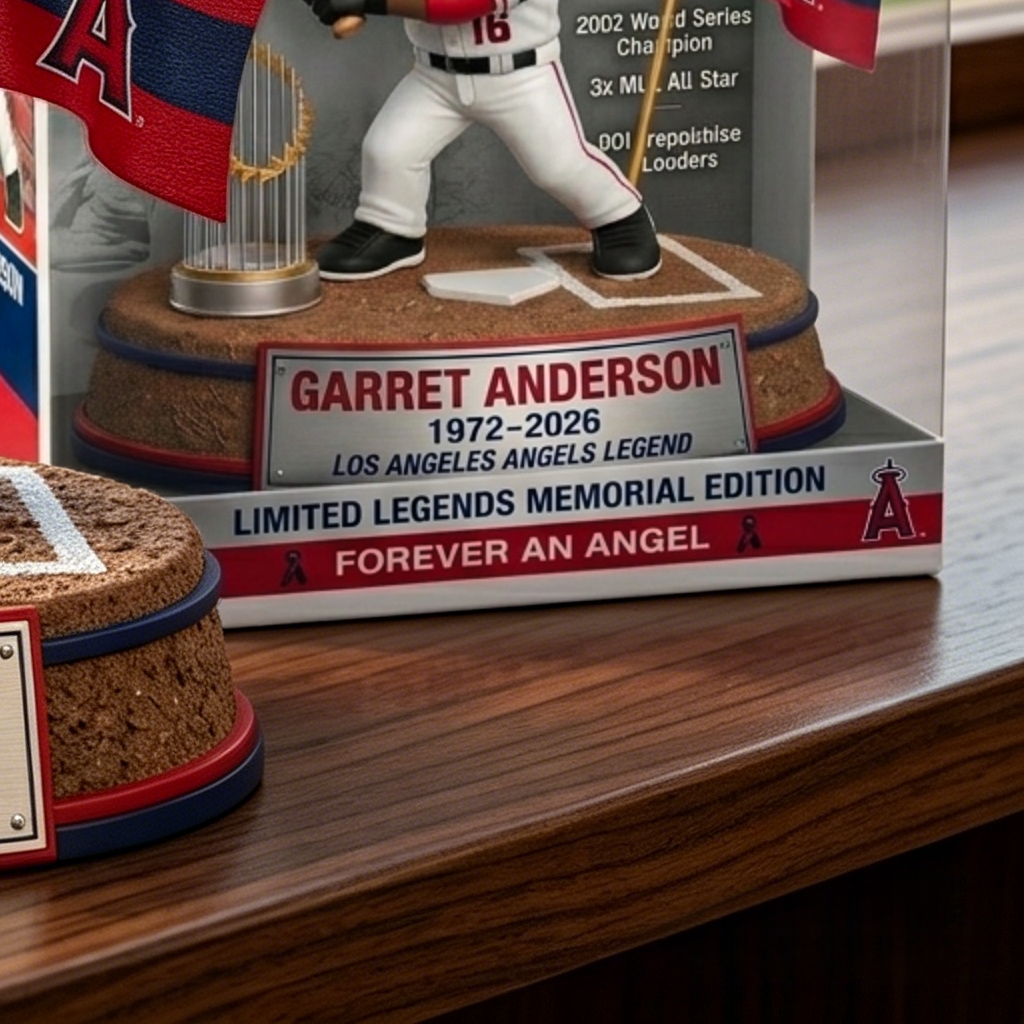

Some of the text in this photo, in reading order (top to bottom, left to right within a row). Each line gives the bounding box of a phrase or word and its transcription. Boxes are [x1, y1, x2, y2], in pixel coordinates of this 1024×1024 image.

[472, 14, 511, 46] 16
[576, 7, 752, 34] 2002 Wod Series
[589, 70, 739, 97] 3x ML All Star
[290, 345, 721, 412] GARRET ANDERSON
[428, 407, 601, 444] 1972-2026
[332, 432, 692, 476] LOS ANGELES ANGELS LEGEND
[233, 466, 826, 536] LIMITED LEGENDS MEMORIAL EDITION
[336, 525, 710, 576] FOREVER AN ANGEL
